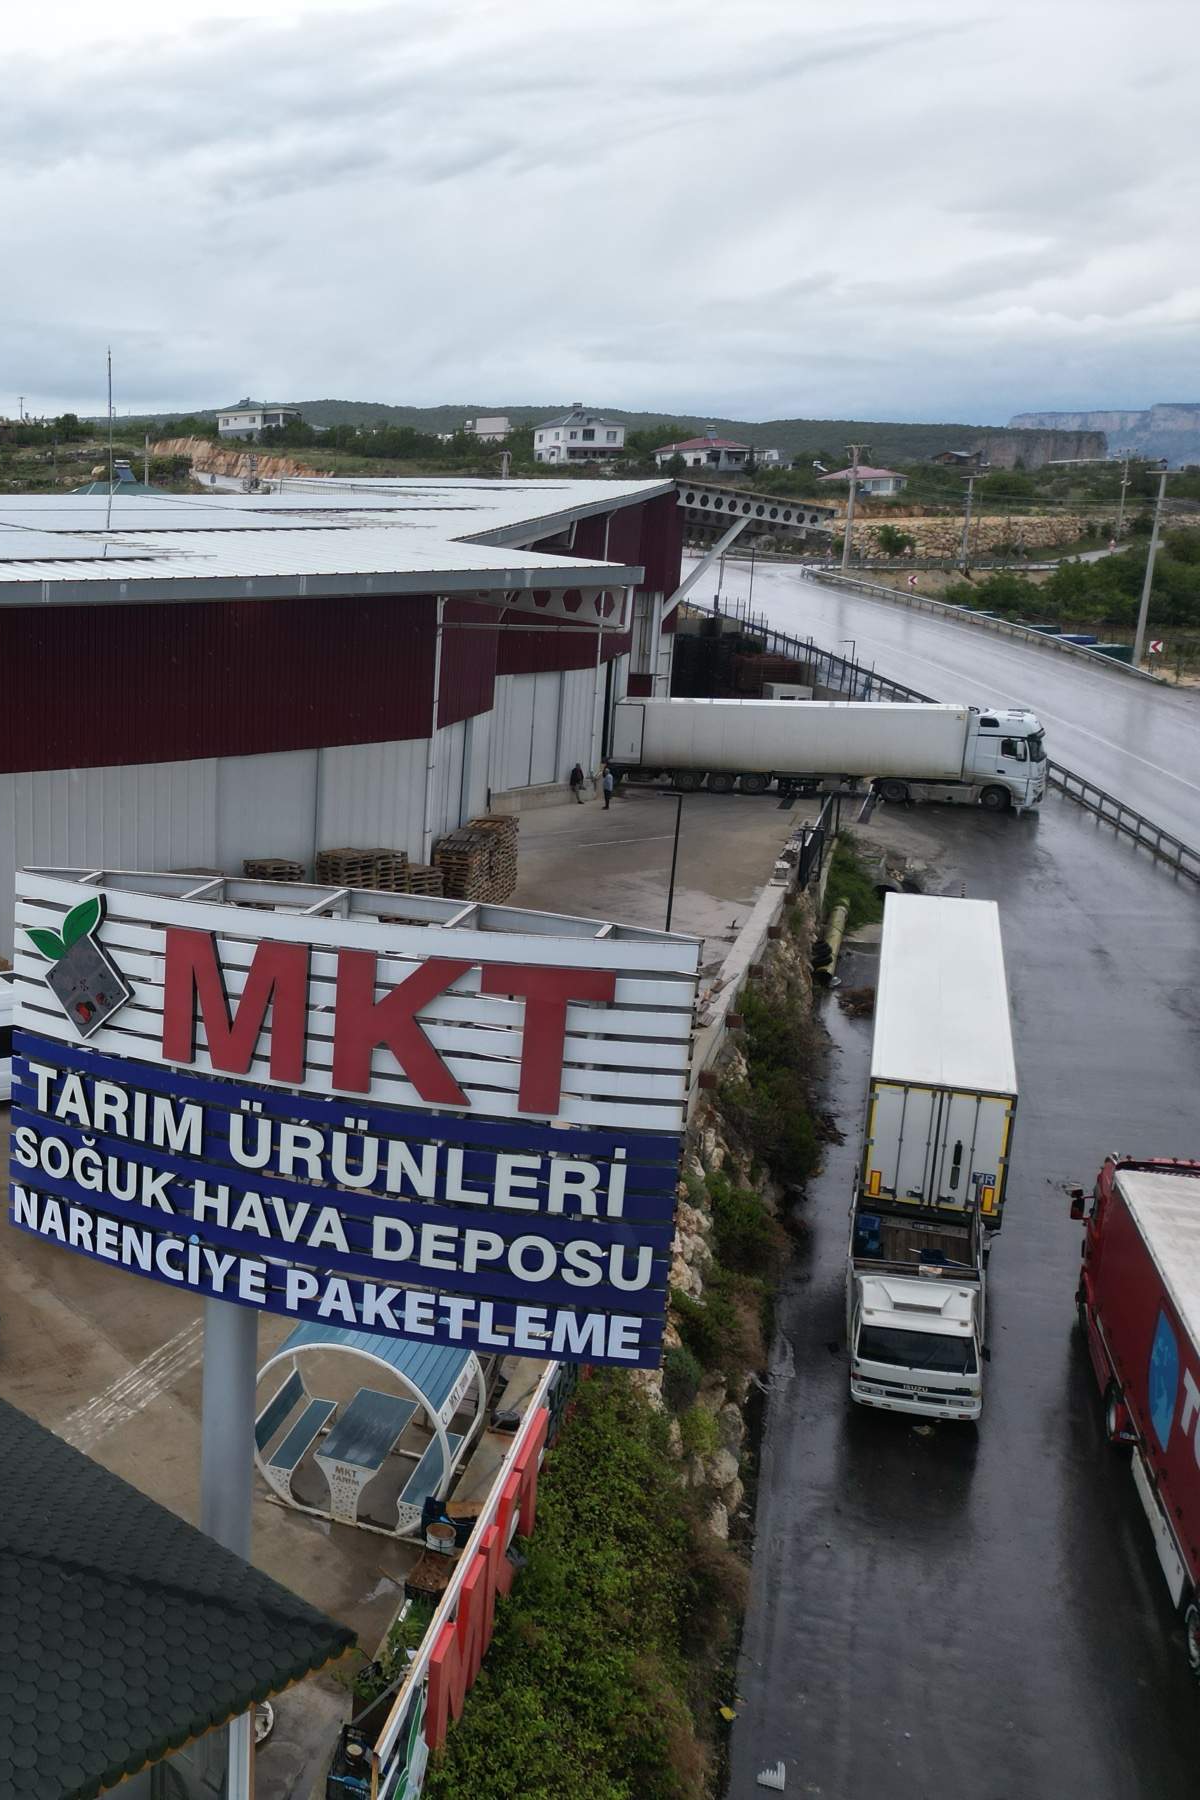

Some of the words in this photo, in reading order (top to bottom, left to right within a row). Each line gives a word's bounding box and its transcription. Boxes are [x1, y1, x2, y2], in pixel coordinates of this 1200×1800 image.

[162, 927, 617, 1116] MKT
[14, 1127, 177, 1215] SOĞUK
[192, 1180, 350, 1254] HAVA
[372, 1215, 654, 1293] DEPOSU
[28, 1062, 203, 1157] TARIM
[229, 1100, 628, 1218] ÜRÜNLERİ
[13, 1186, 267, 1305] NARENCİYE
[284, 1270, 644, 1361] PAKETLEME
[903, 1384, 928, 1393] ISUZU
[335, 1465, 357, 1478] MKT
